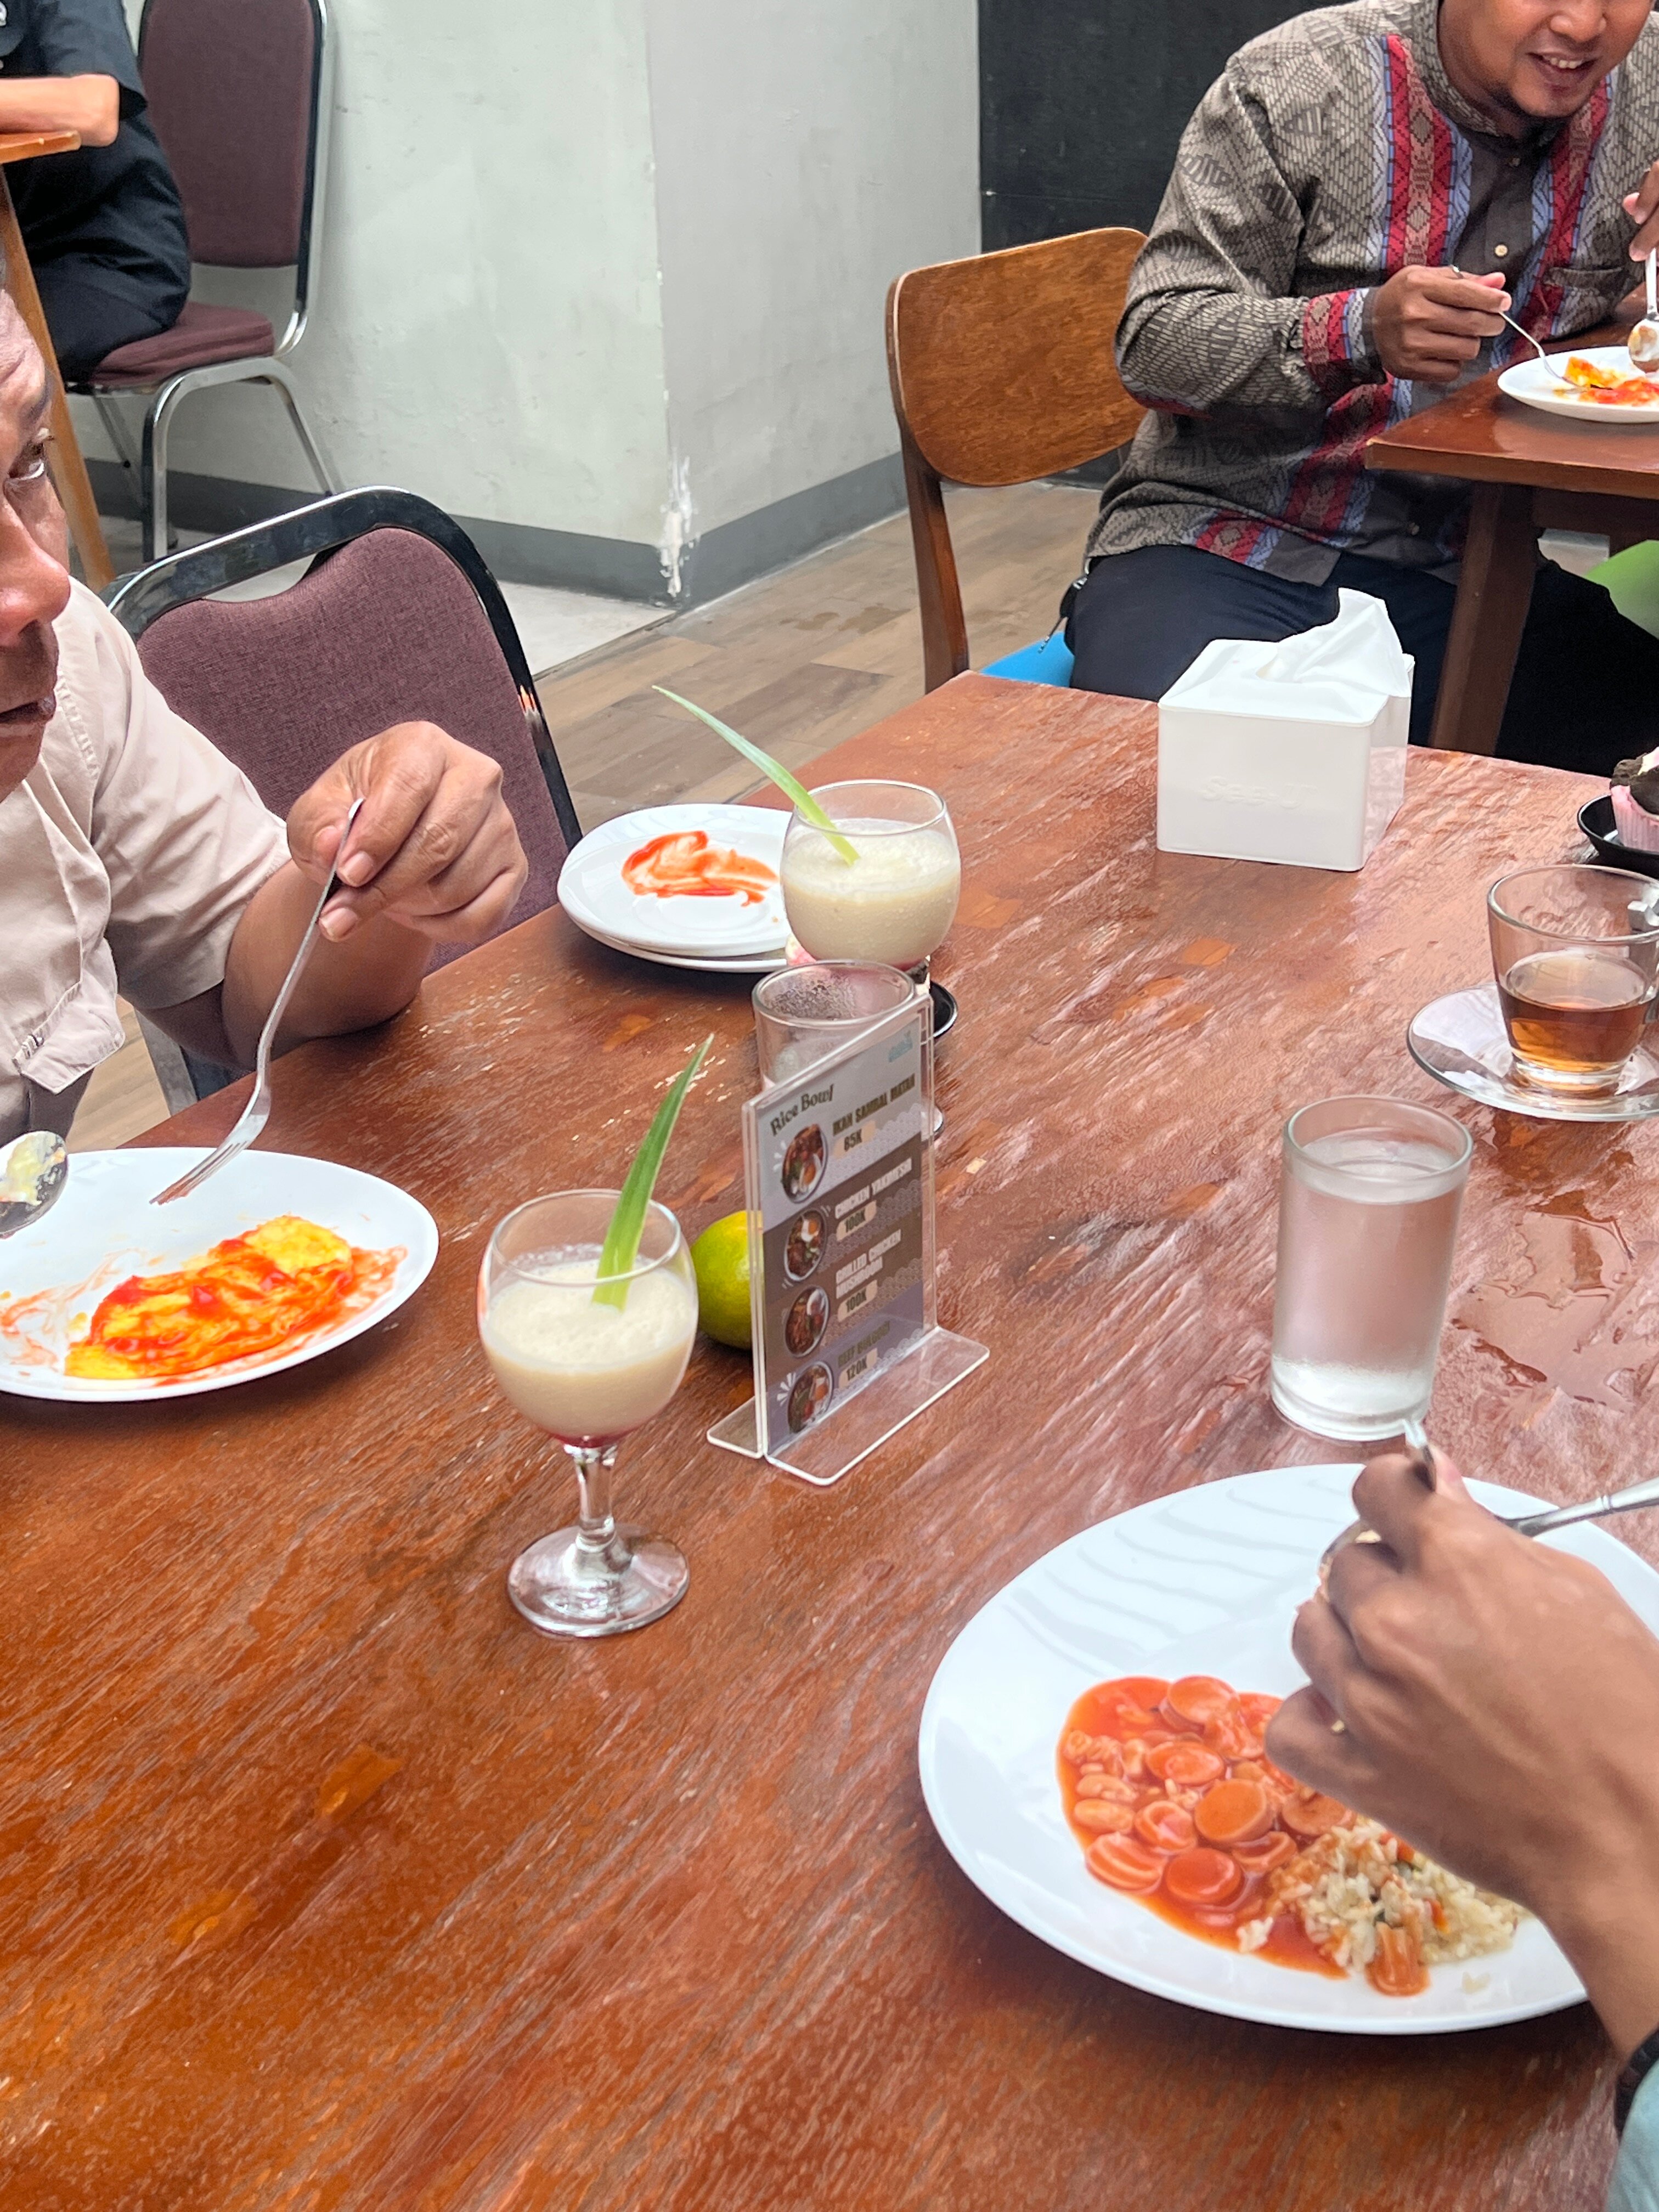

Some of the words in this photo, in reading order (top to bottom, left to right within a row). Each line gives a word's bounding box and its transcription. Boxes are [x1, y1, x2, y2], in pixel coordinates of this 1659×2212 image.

[770, 1105, 798, 1136] Rice
[801, 1084, 833, 1111] Bowl
[847, 1355, 867, 1380] 120K
